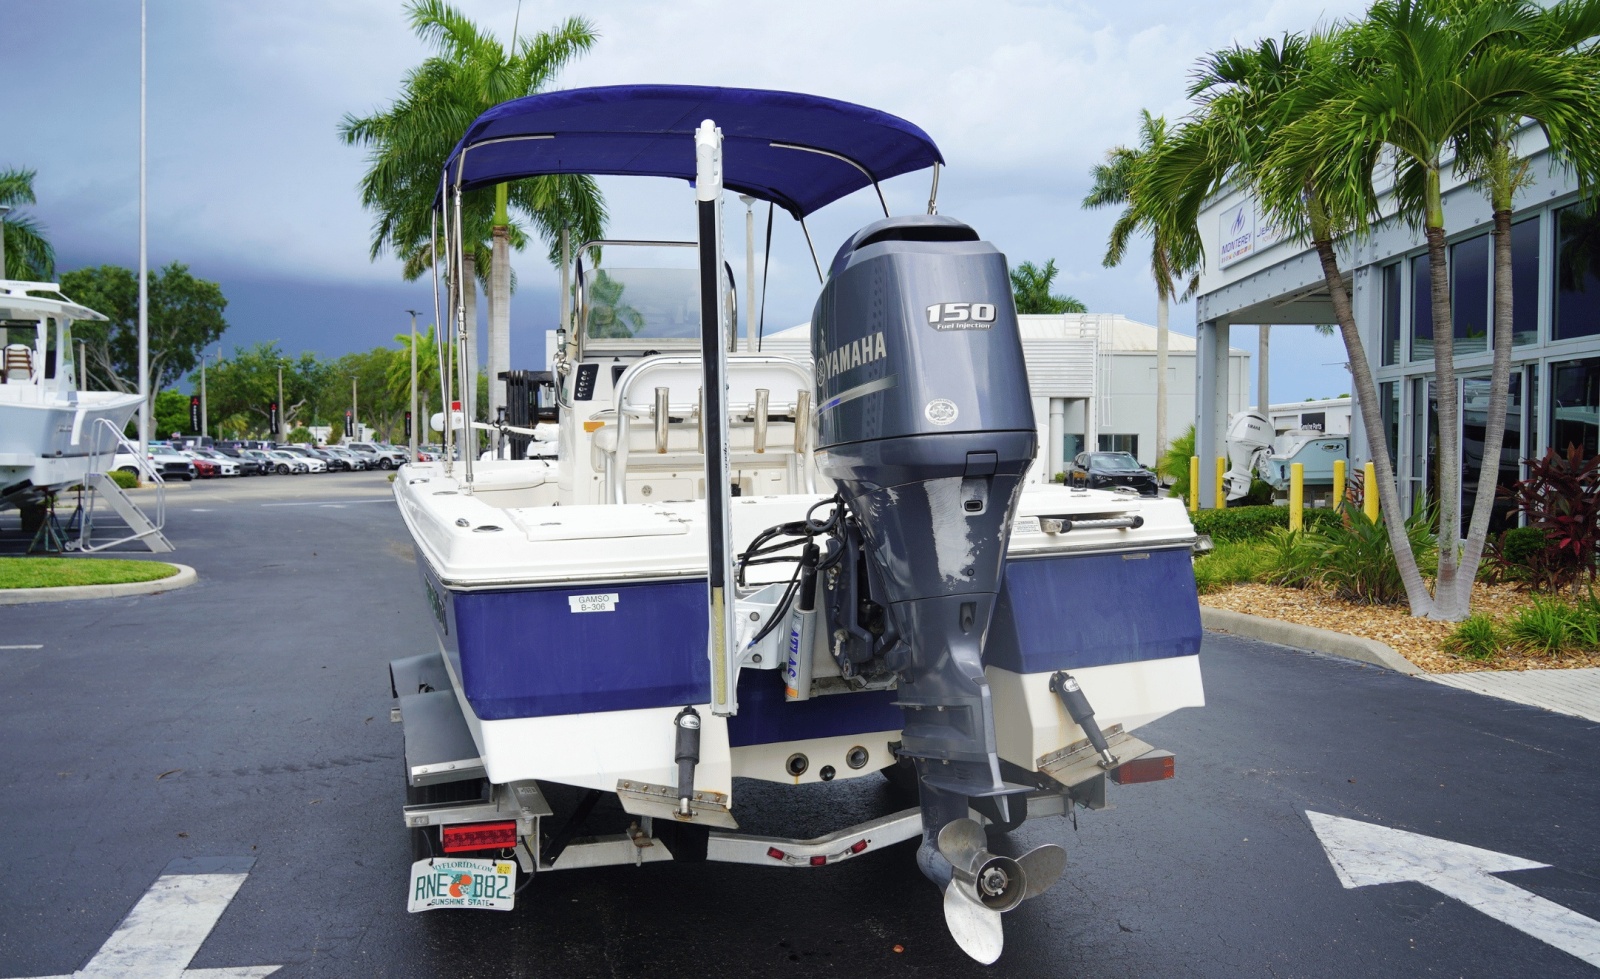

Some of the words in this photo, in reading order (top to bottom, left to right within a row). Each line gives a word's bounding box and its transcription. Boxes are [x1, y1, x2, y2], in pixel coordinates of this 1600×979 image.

[1221, 232, 1252, 256] MONTEREY
[927, 303, 996, 323] 150
[825, 331, 887, 380] YAMAHA
[579, 594, 610, 604] GAMSO
[581, 602, 606, 611] B-306
[786, 629, 799, 678] ATLAS
[432, 861, 493, 873] MYFLORIDA.COM
[415, 873, 448, 901] RNE
[472, 873, 508, 899] B82
[431, 898, 465, 907] SUNSHINE
[468, 898, 490, 907] STATE
